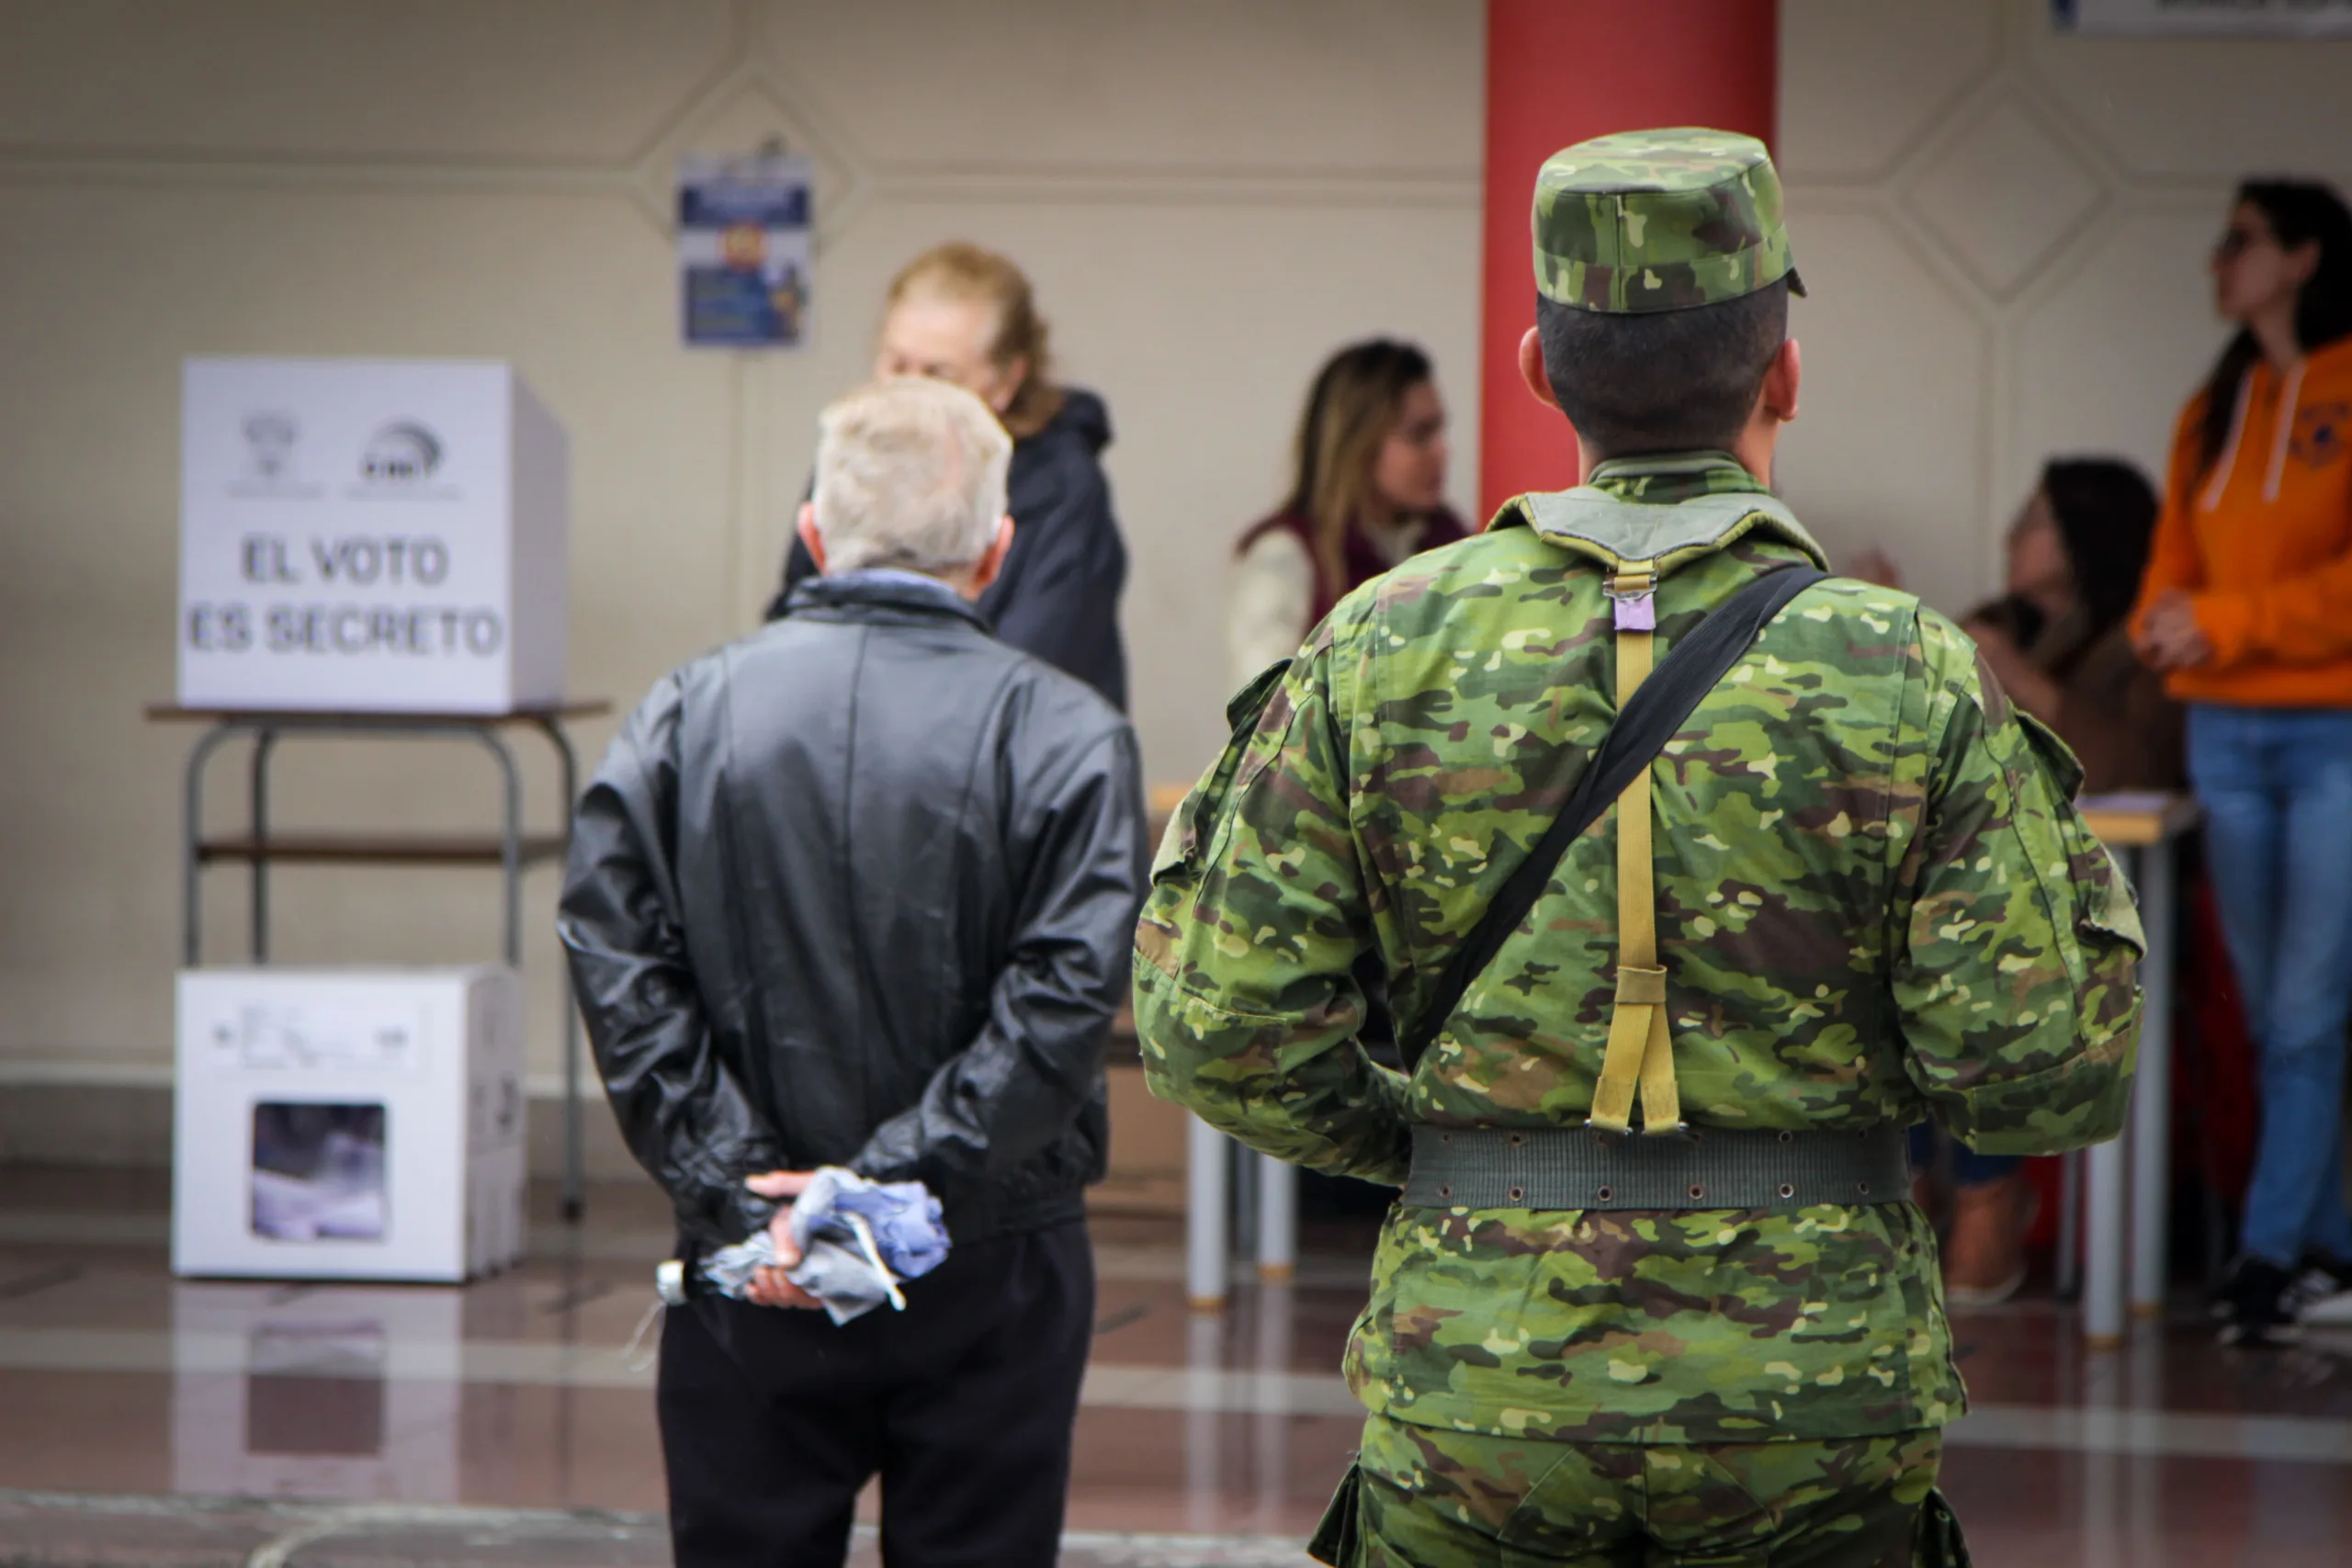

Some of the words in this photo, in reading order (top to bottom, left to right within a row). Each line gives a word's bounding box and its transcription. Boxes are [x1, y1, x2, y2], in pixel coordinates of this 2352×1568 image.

[240, 532, 300, 585] EL
[310, 533, 450, 587] VOTO
[187, 603, 254, 653] ES
[265, 604, 503, 658] SECRETO
